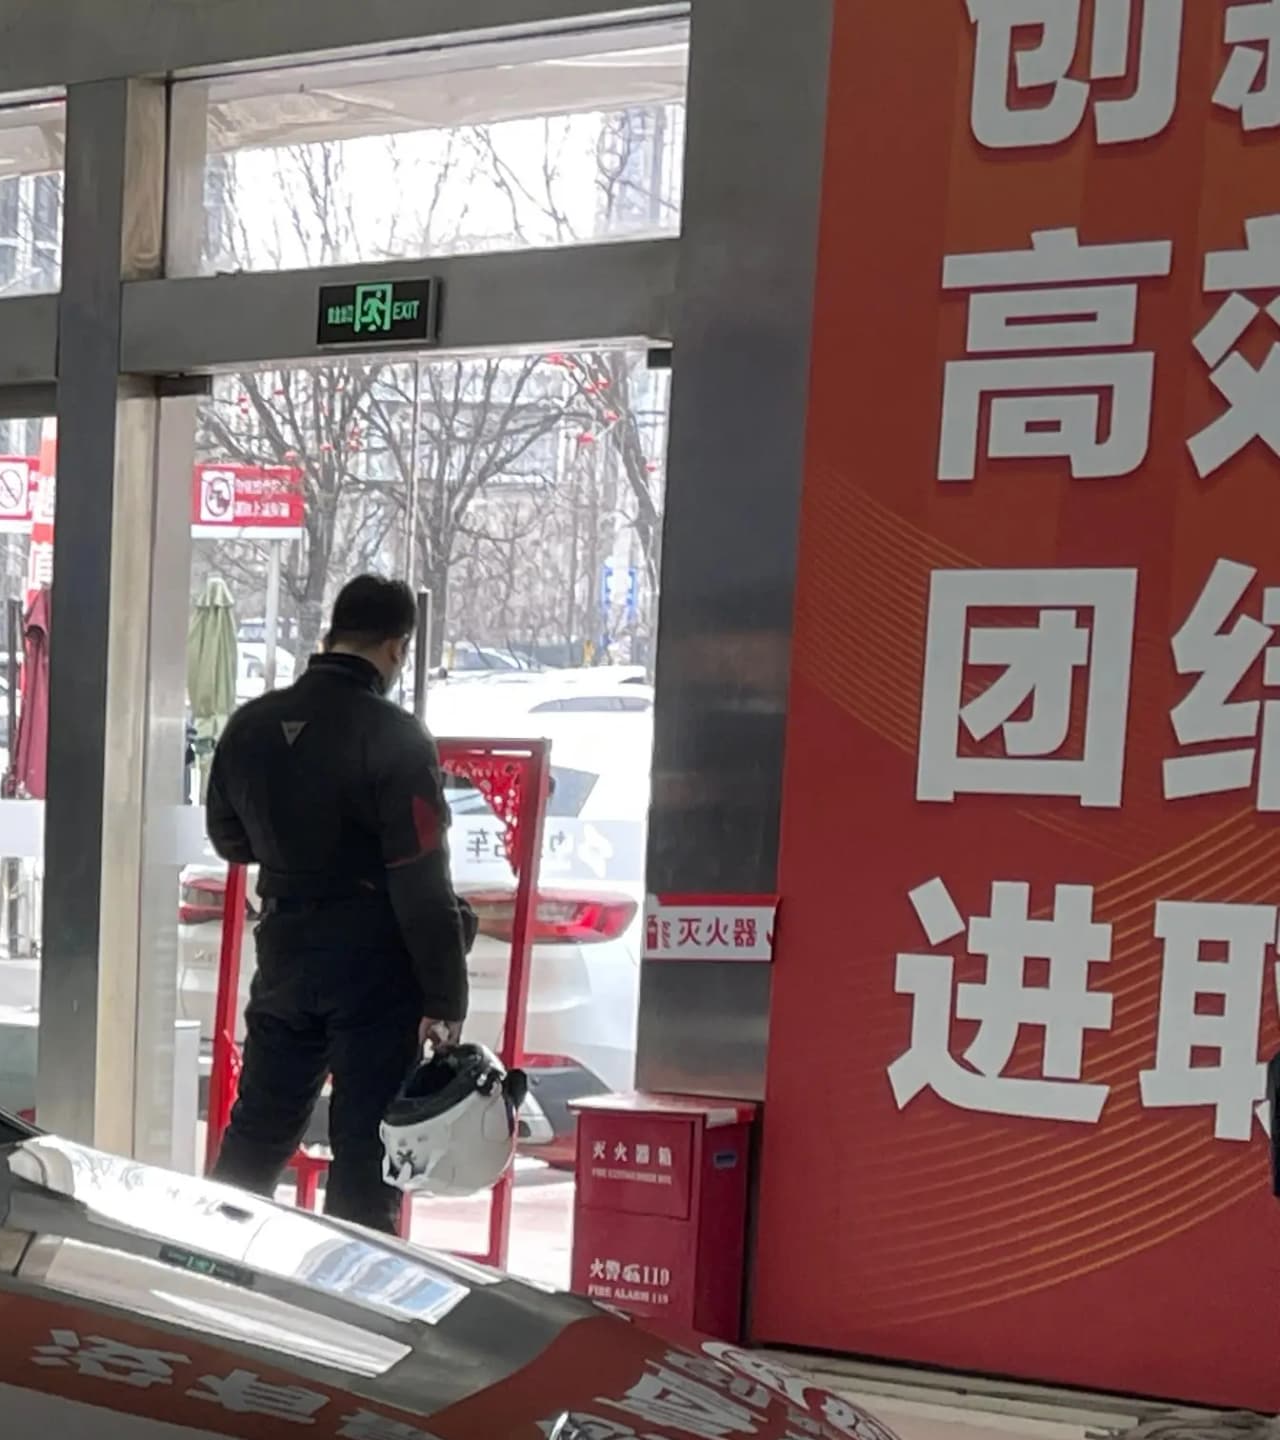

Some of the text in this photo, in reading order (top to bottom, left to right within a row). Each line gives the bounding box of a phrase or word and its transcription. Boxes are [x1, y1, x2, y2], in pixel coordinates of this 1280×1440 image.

[965, 0, 1280, 149] 创
[392, 300, 420, 320] EXIT
[677, 916, 757, 947] 灭火器
